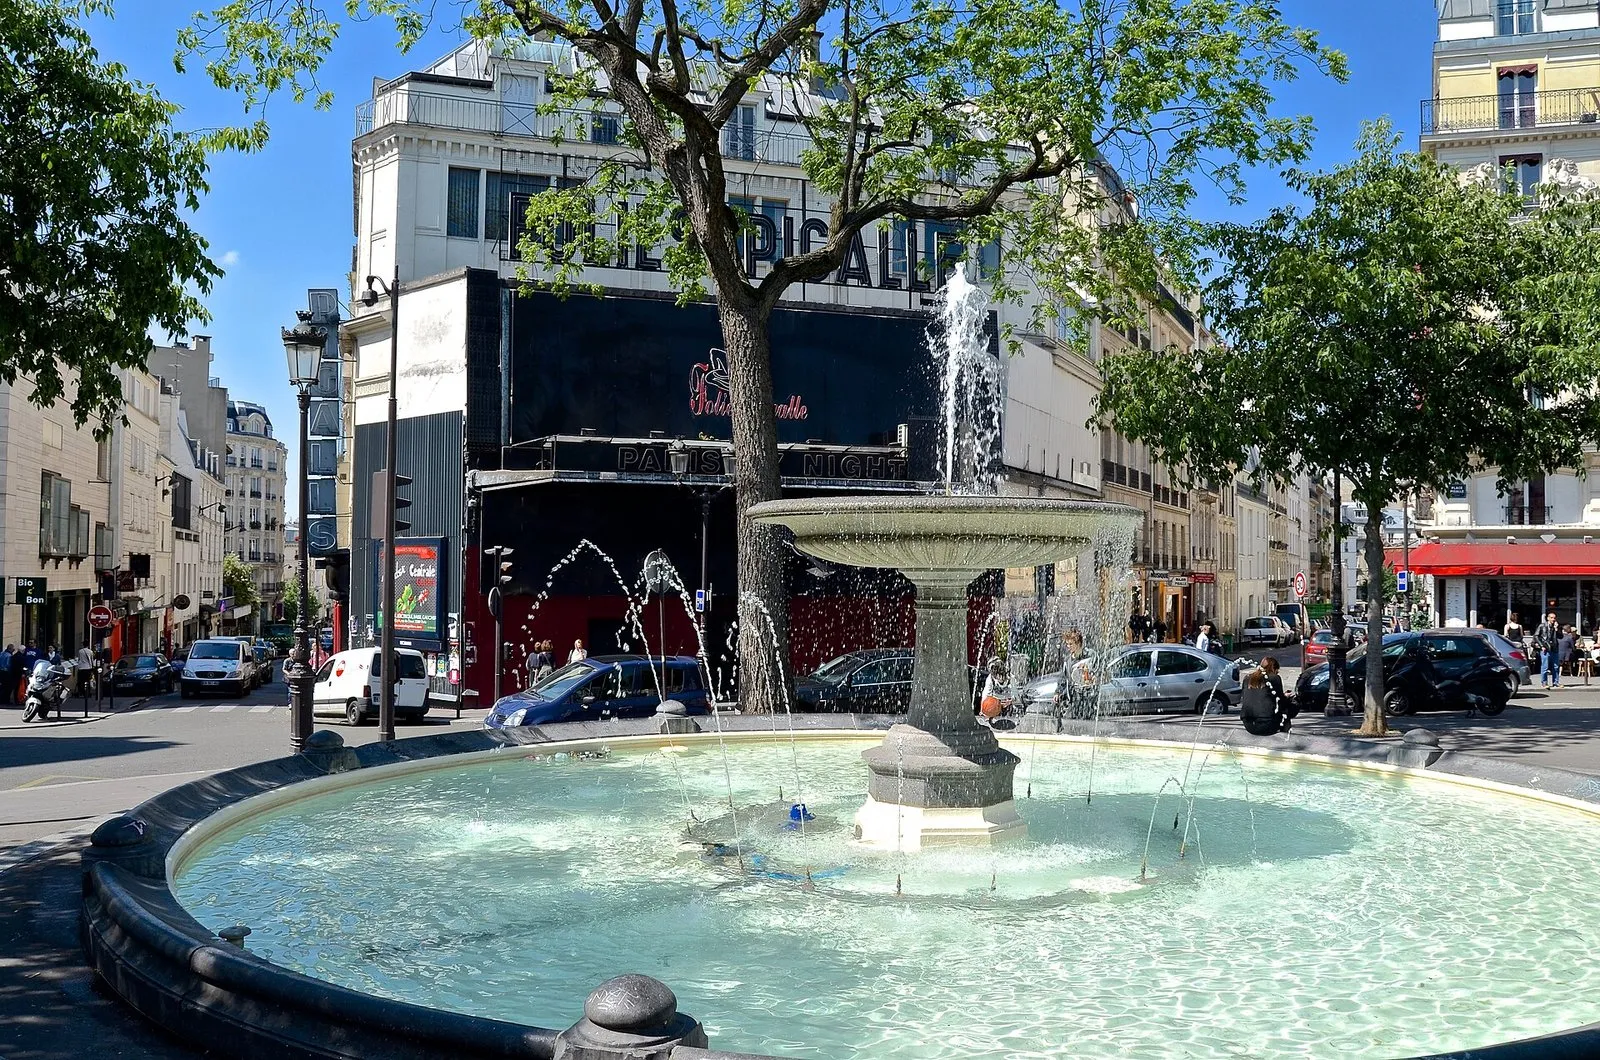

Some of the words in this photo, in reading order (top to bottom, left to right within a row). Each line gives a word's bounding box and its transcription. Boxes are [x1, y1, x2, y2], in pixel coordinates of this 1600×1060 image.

[508, 191, 691, 270] FOLIE
[618, 446, 721, 474] PAIS
[803, 453, 906, 479] NIGHT
